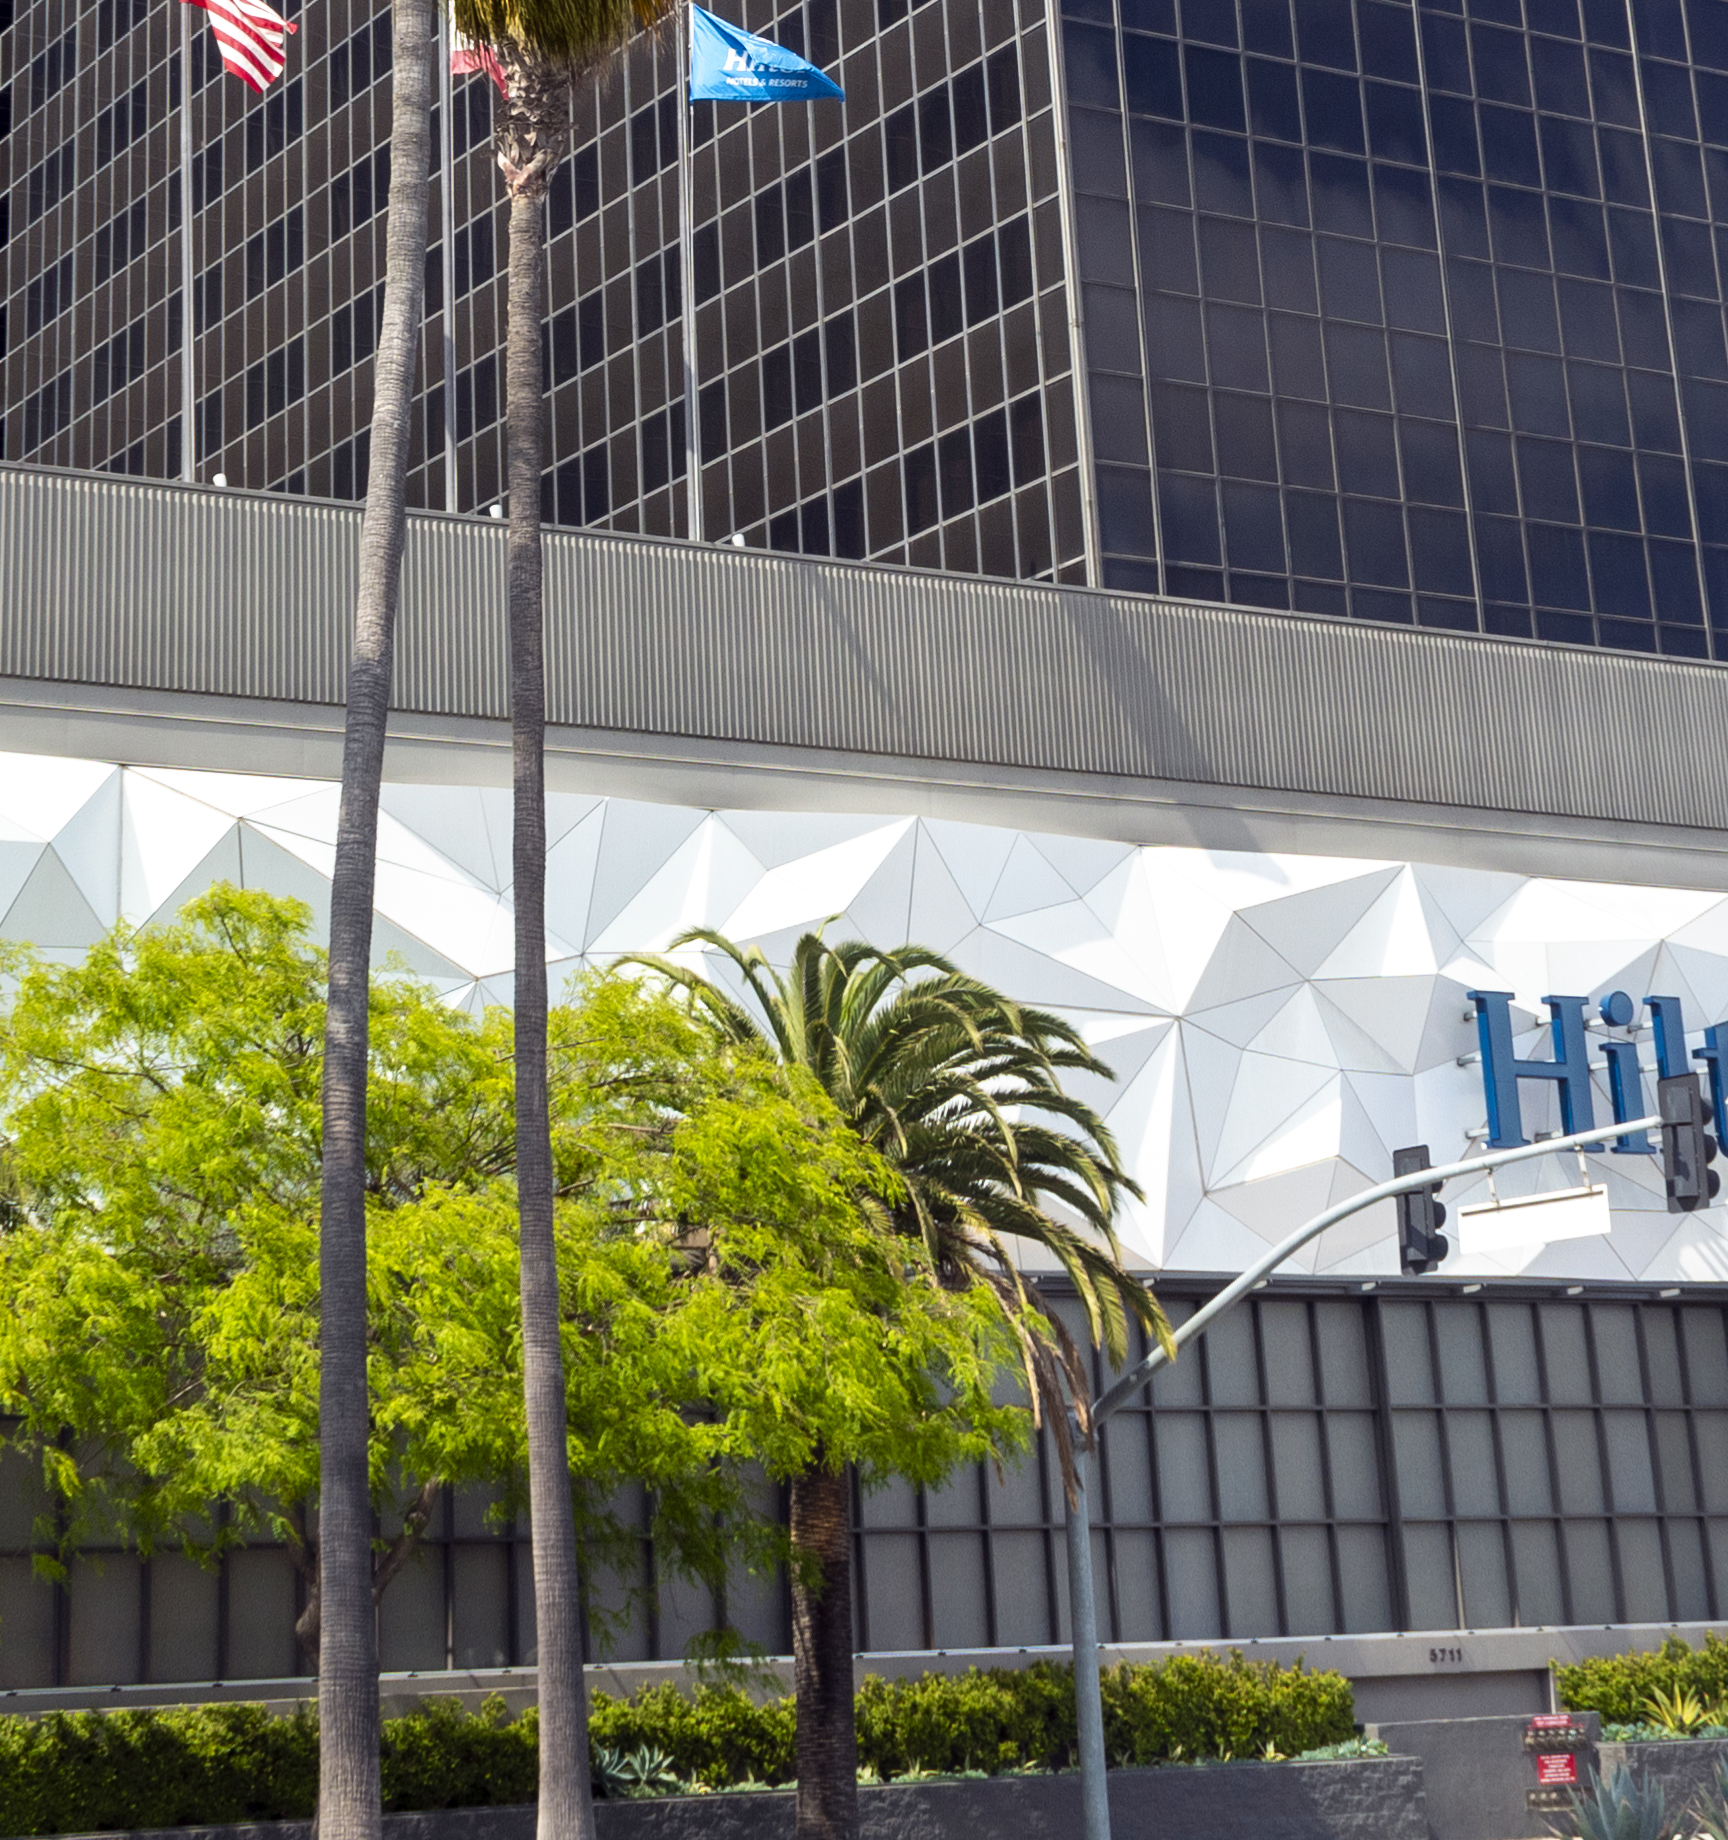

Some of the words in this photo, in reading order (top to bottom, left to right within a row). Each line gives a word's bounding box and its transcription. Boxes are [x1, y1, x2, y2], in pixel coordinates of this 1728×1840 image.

[725, 76, 759, 86] HOTELS
[759, 78, 766, 87] &
[768, 78, 808, 89] RESORTS
[1429, 1647, 1462, 1663] 5711
